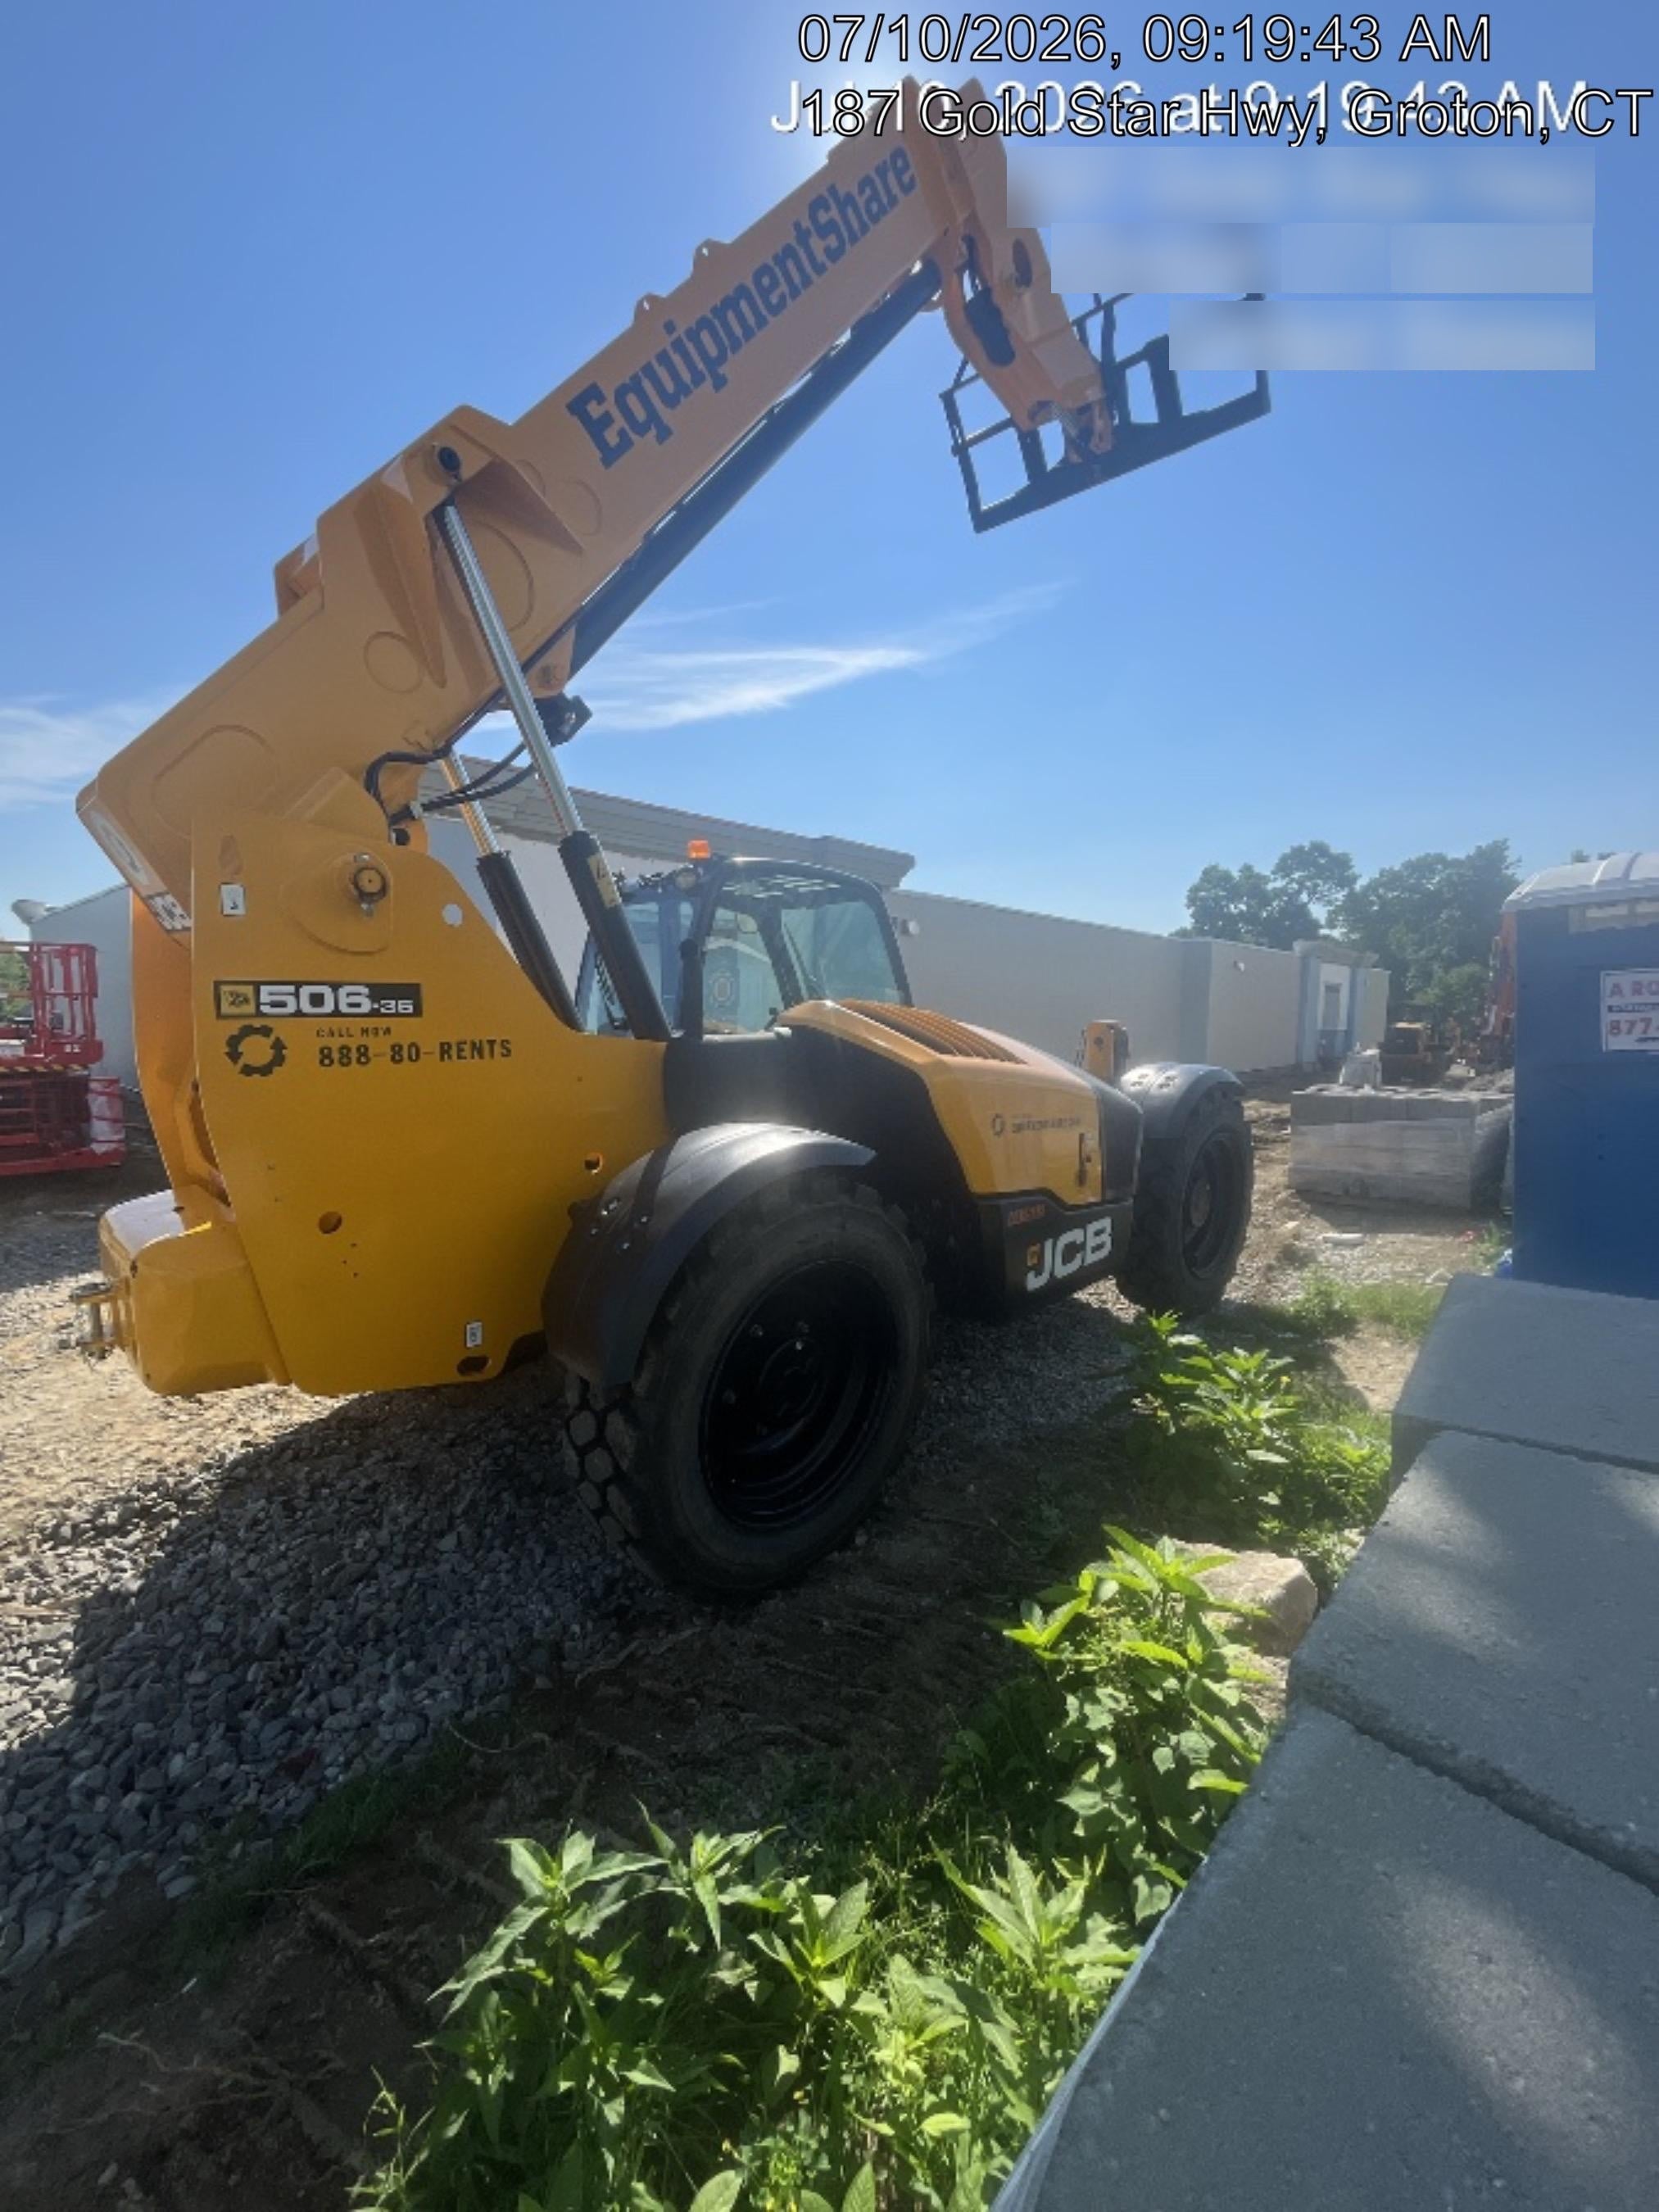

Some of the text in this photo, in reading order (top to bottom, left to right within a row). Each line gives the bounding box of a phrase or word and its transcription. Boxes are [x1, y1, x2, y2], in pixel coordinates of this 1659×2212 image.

[565, 146, 918, 469] EquipmentShare
[316, 1027, 392, 1038] CALL NOW
[319, 1039, 512, 1067] 888-80-RENTS
[1027, 1217, 1112, 1292] JCB
